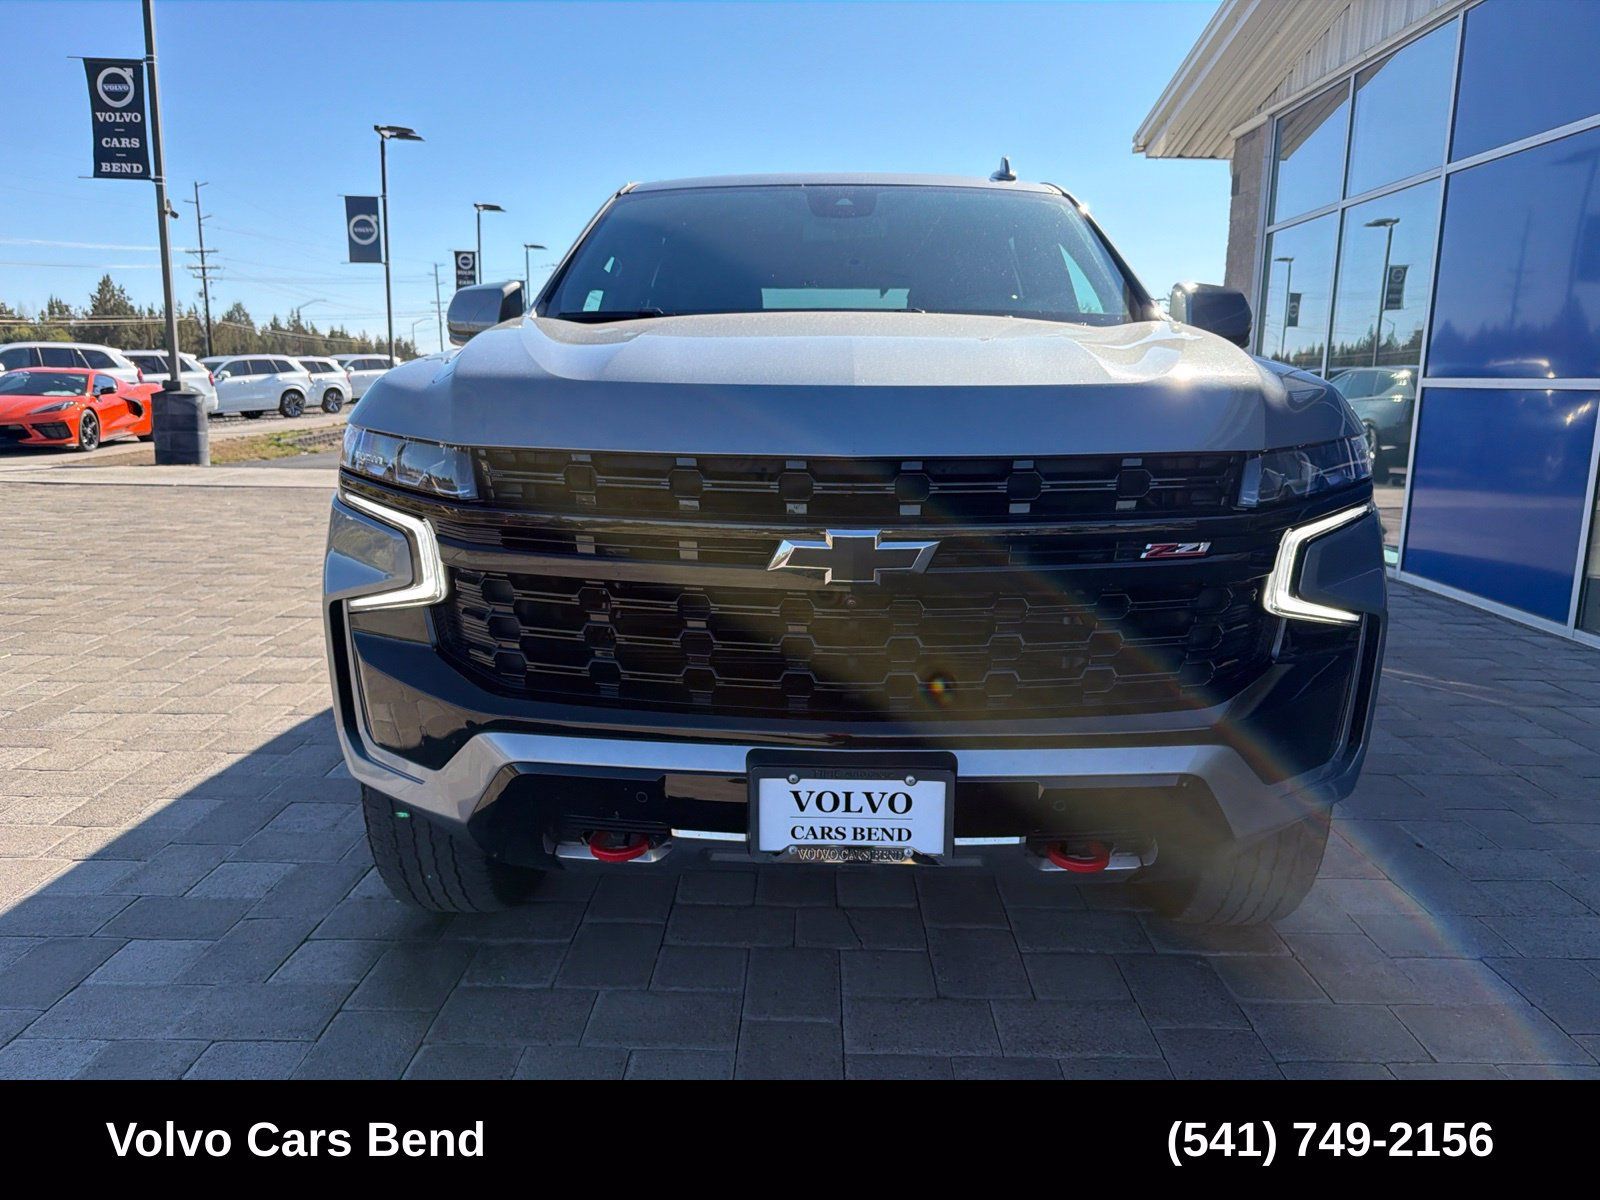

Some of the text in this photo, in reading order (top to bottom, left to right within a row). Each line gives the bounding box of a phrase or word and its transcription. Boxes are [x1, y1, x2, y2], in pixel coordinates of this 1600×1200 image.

[95, 112, 141, 122] VOLVO
[101, 137, 140, 148] CARS
[100, 162, 143, 173] BEND
[1140, 542, 1211, 558] Z71
[789, 790, 913, 814] VOLVO
[790, 825, 912, 842] CARS BEND
[798, 848, 838, 861] VOLVO
